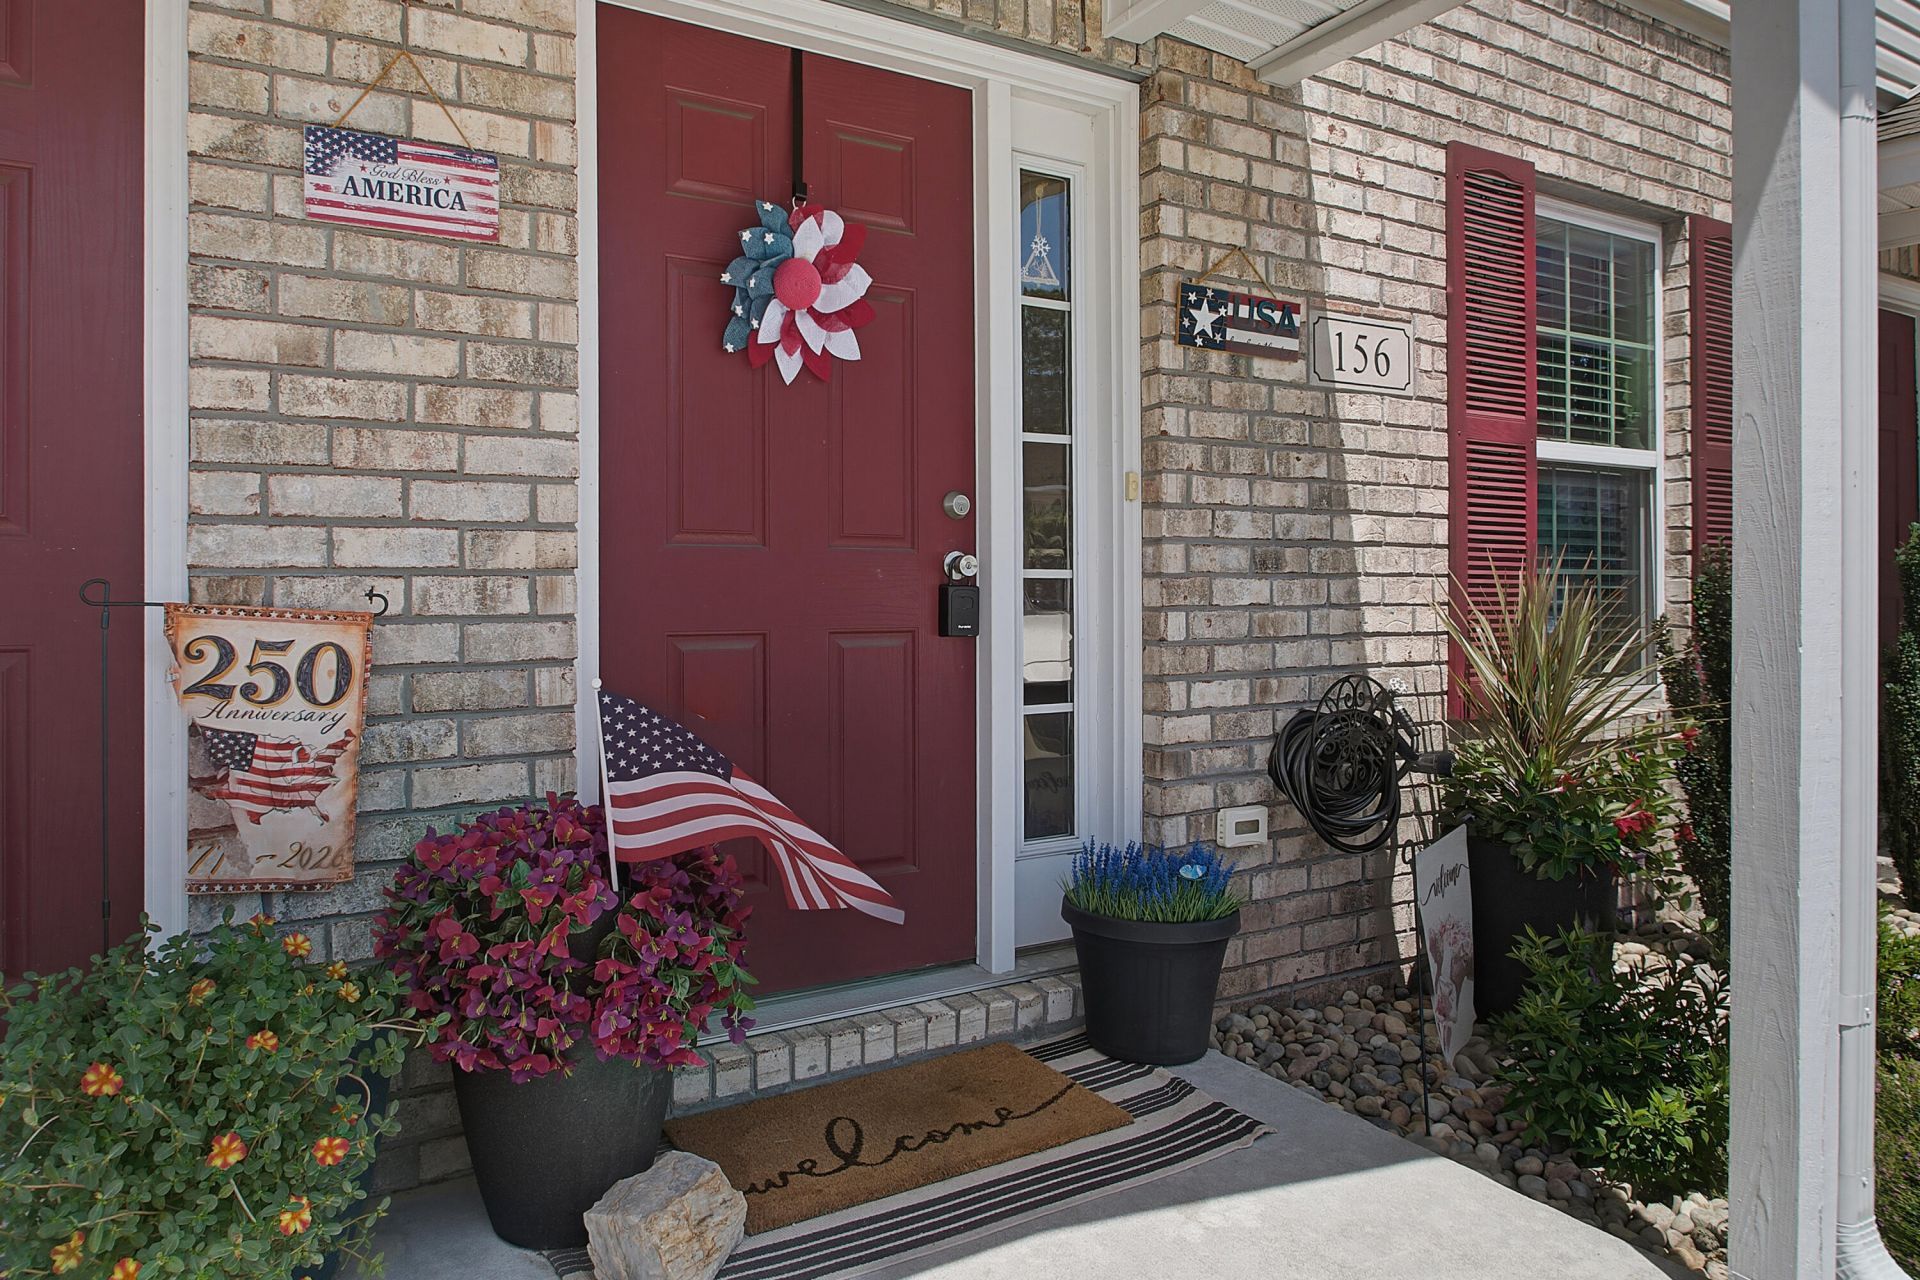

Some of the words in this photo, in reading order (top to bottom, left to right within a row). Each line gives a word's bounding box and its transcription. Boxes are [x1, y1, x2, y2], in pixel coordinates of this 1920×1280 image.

[341, 175, 468, 212] AMERICA
[369, 164, 400, 180] God
[401, 167, 442, 186] Bless
[1233, 293, 1297, 336] USA
[1335, 331, 1391, 377] 156
[182, 635, 356, 707] 250
[197, 700, 348, 735] Anniversary
